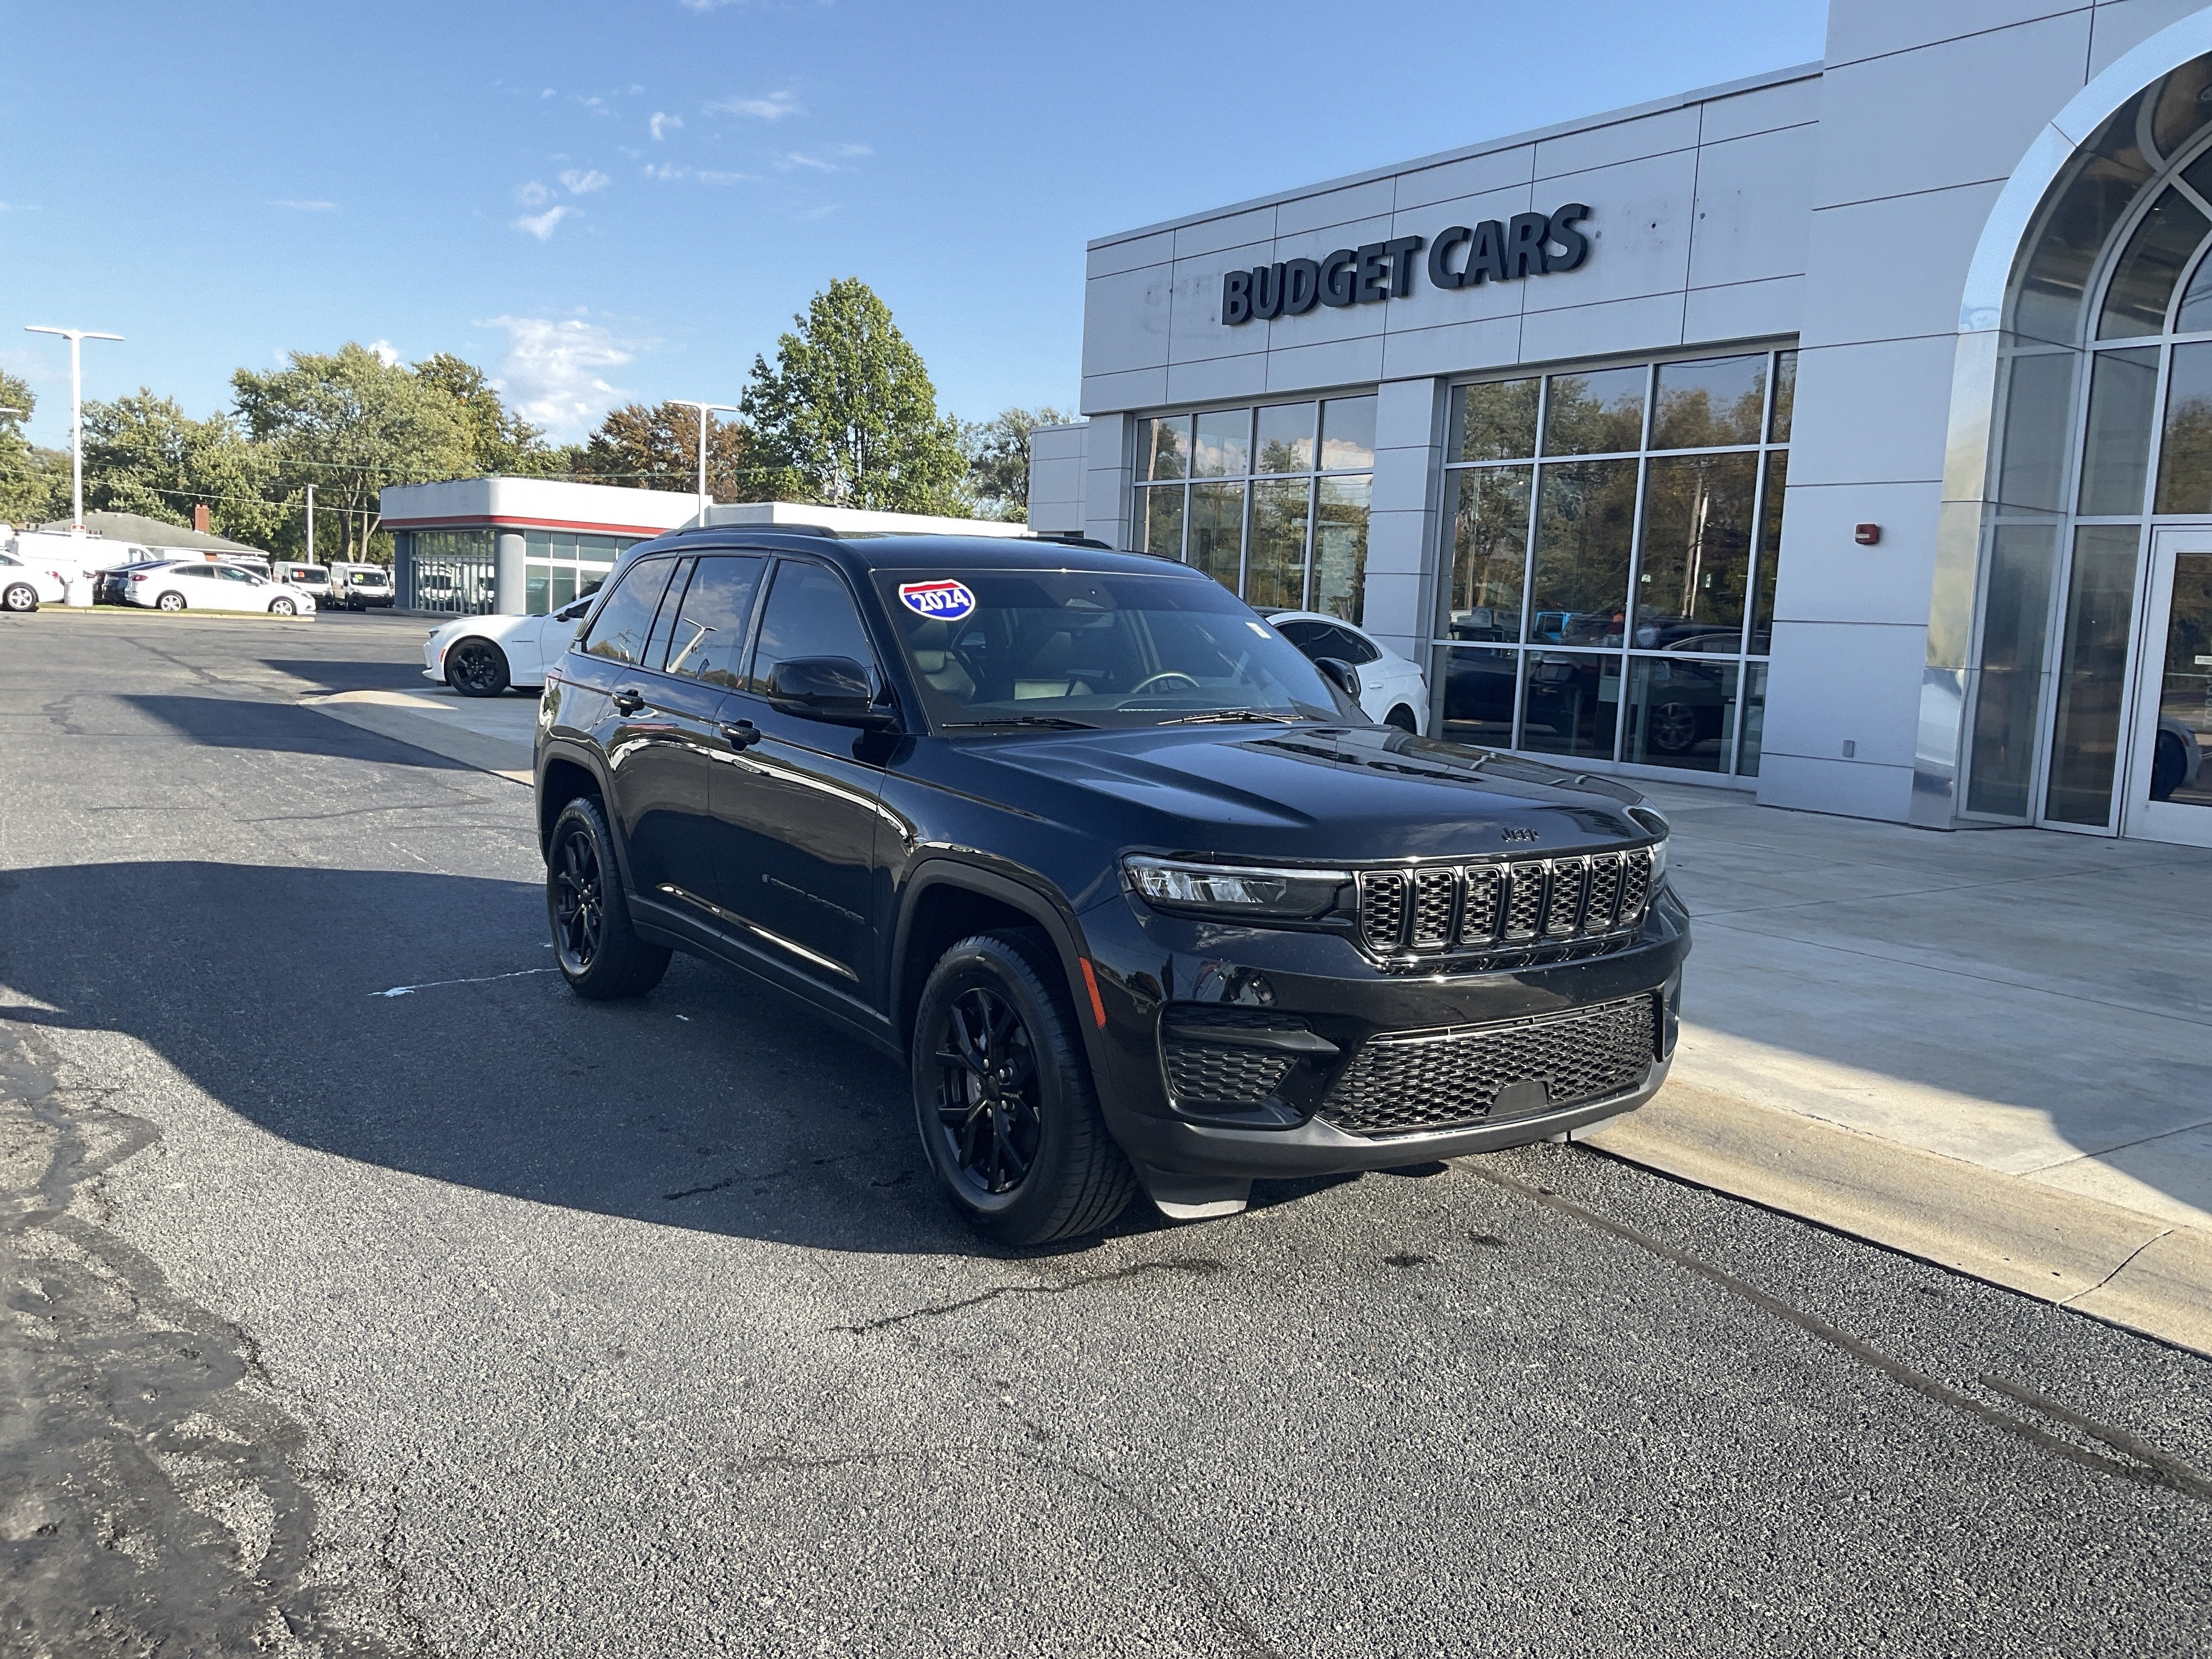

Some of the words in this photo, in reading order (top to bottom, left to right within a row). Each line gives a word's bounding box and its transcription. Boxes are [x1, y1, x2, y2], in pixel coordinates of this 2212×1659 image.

[1222, 235, 1423, 325] BUDGET
[1428, 203, 1589, 290] CARS
[911, 589, 970, 612] 2024
[1501, 827, 1539, 842] Jeep
